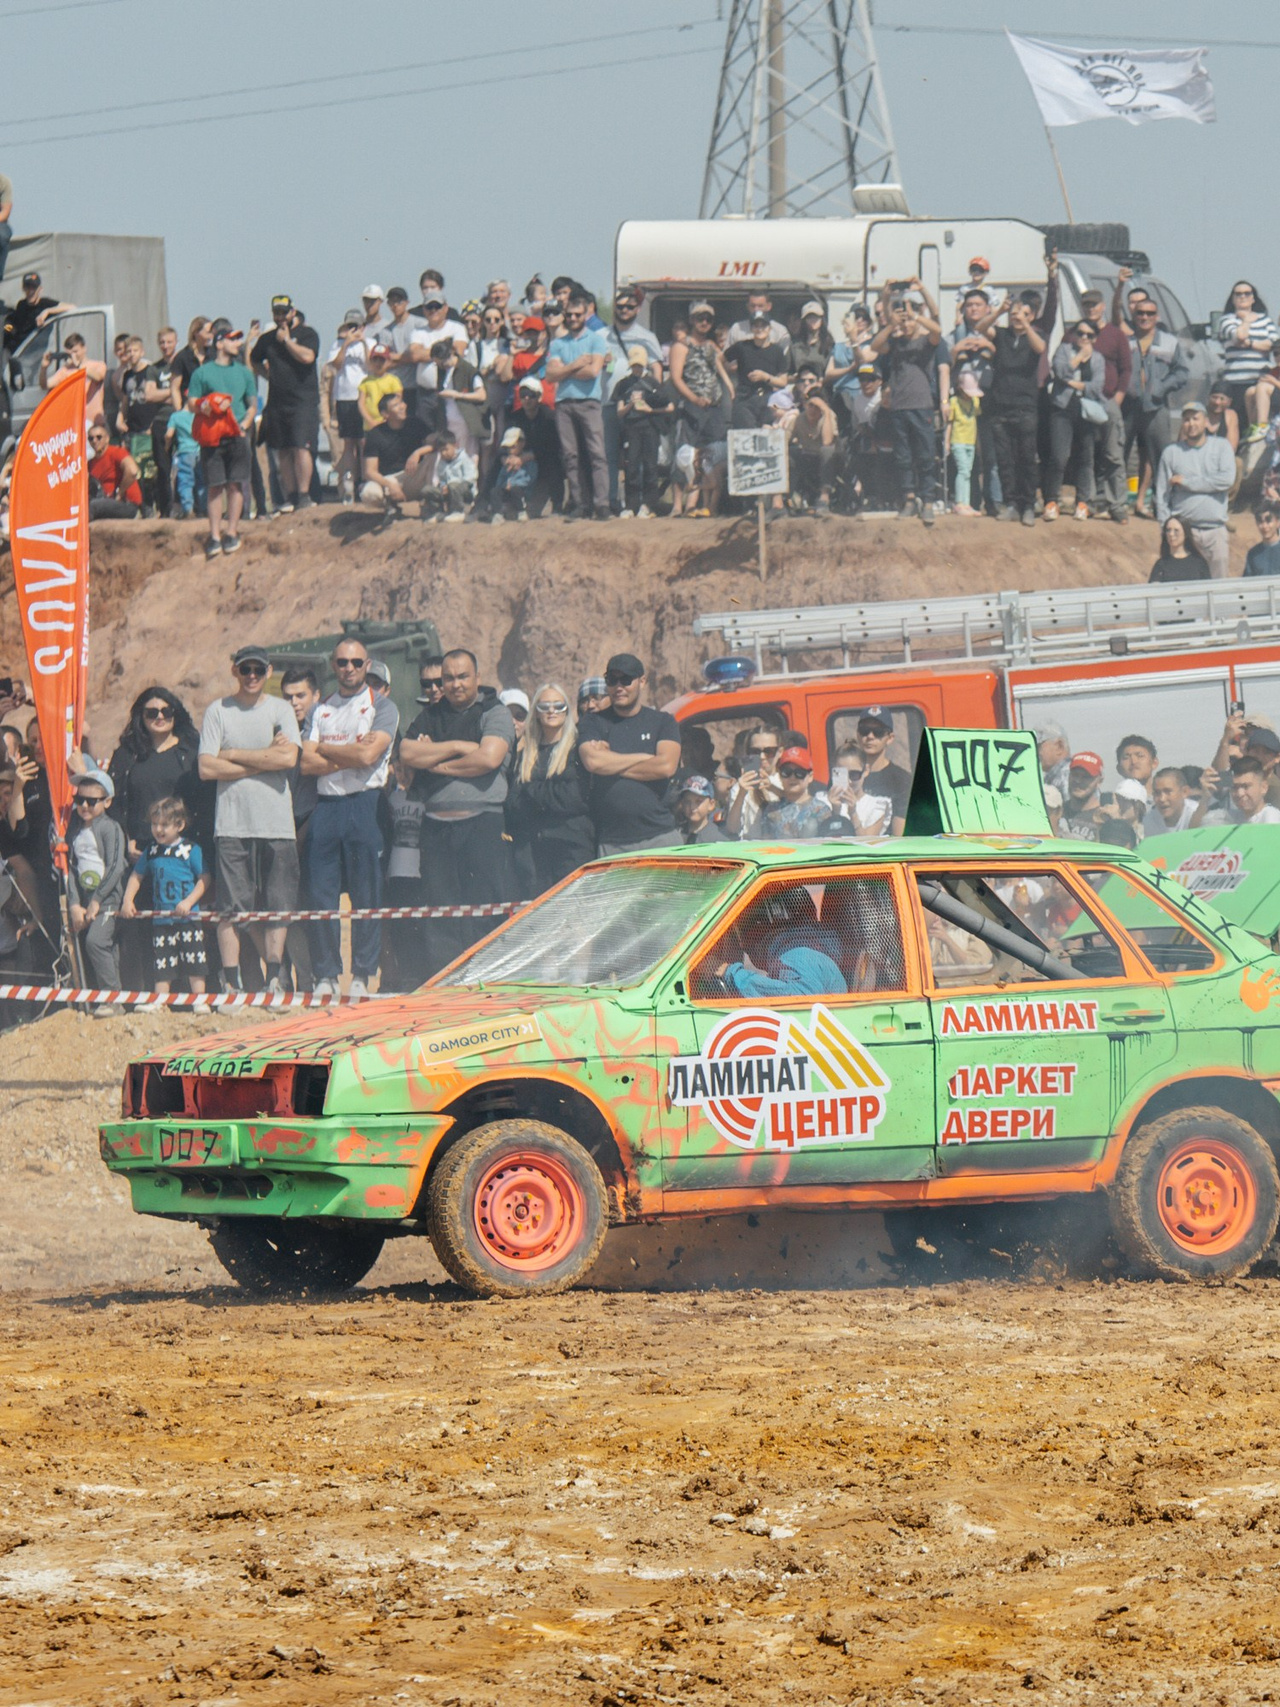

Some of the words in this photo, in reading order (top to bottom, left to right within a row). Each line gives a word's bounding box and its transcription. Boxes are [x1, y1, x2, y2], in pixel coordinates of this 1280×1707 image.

[717, 261, 766, 276] LMC
[941, 739, 1032, 793] 007
[942, 1003, 1097, 1034] ЛАМИНАТ
[428, 1033, 489, 1054] QAMQOR
[491, 1025, 521, 1041] CITY
[672, 1055, 809, 1100] ЛАМИНАТ
[949, 1065, 1076, 1098] ПАРКЕТ
[770, 1095, 881, 1148] ЦЕНТР
[941, 1108, 1055, 1145] ДВЕРИ
